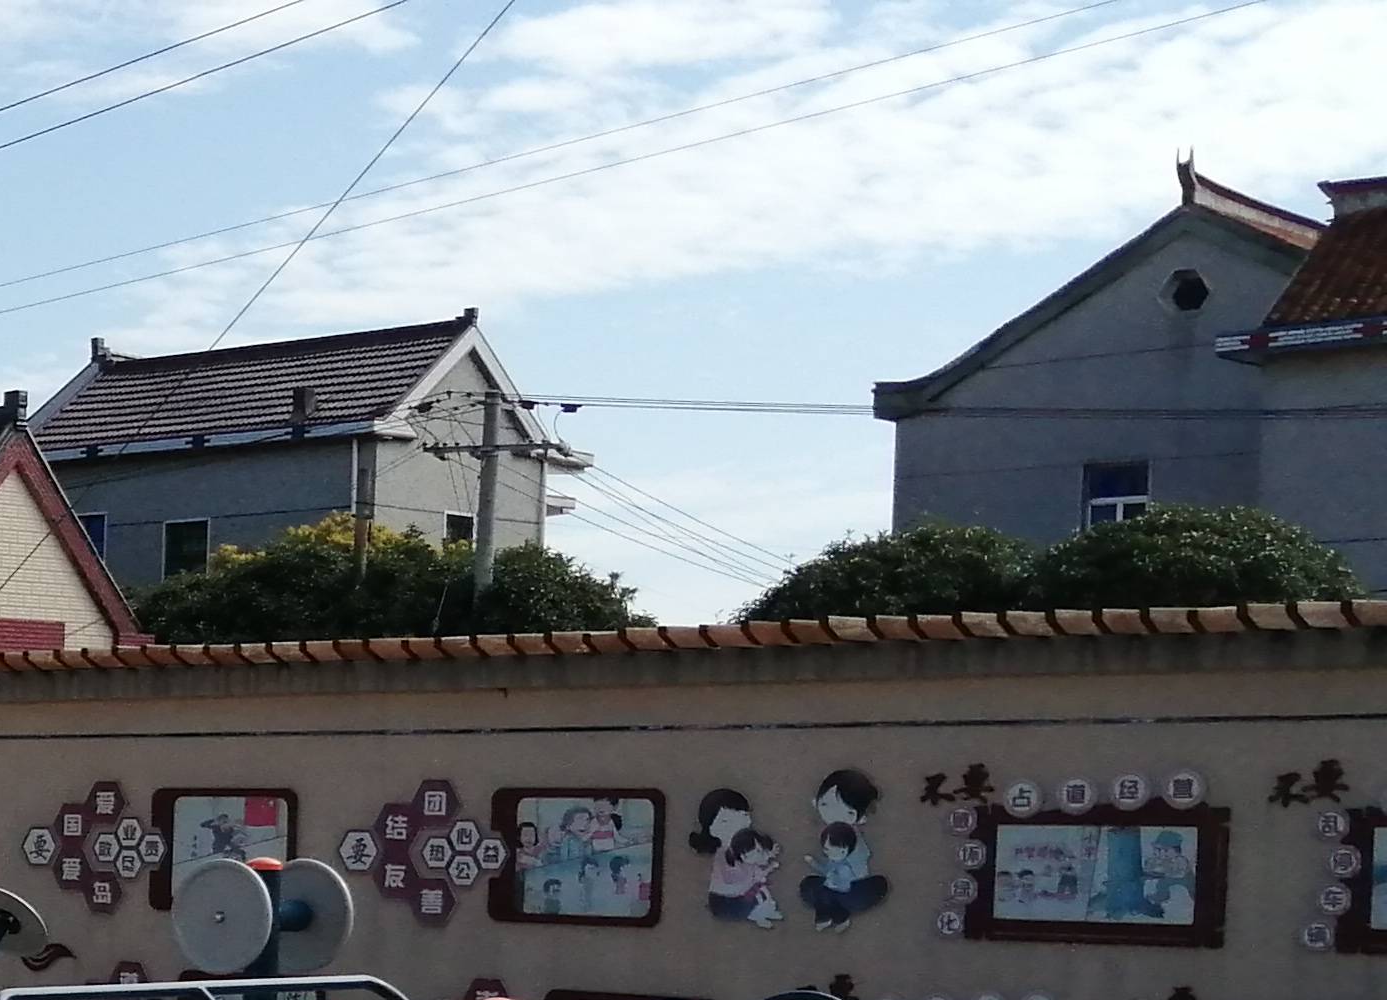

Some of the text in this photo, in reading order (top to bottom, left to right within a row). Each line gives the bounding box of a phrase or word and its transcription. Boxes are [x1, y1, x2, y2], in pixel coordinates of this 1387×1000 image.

[1012, 777, 1193, 808] 占道经营
[31, 834, 52, 861] 要
[346, 837, 373, 866] 要
